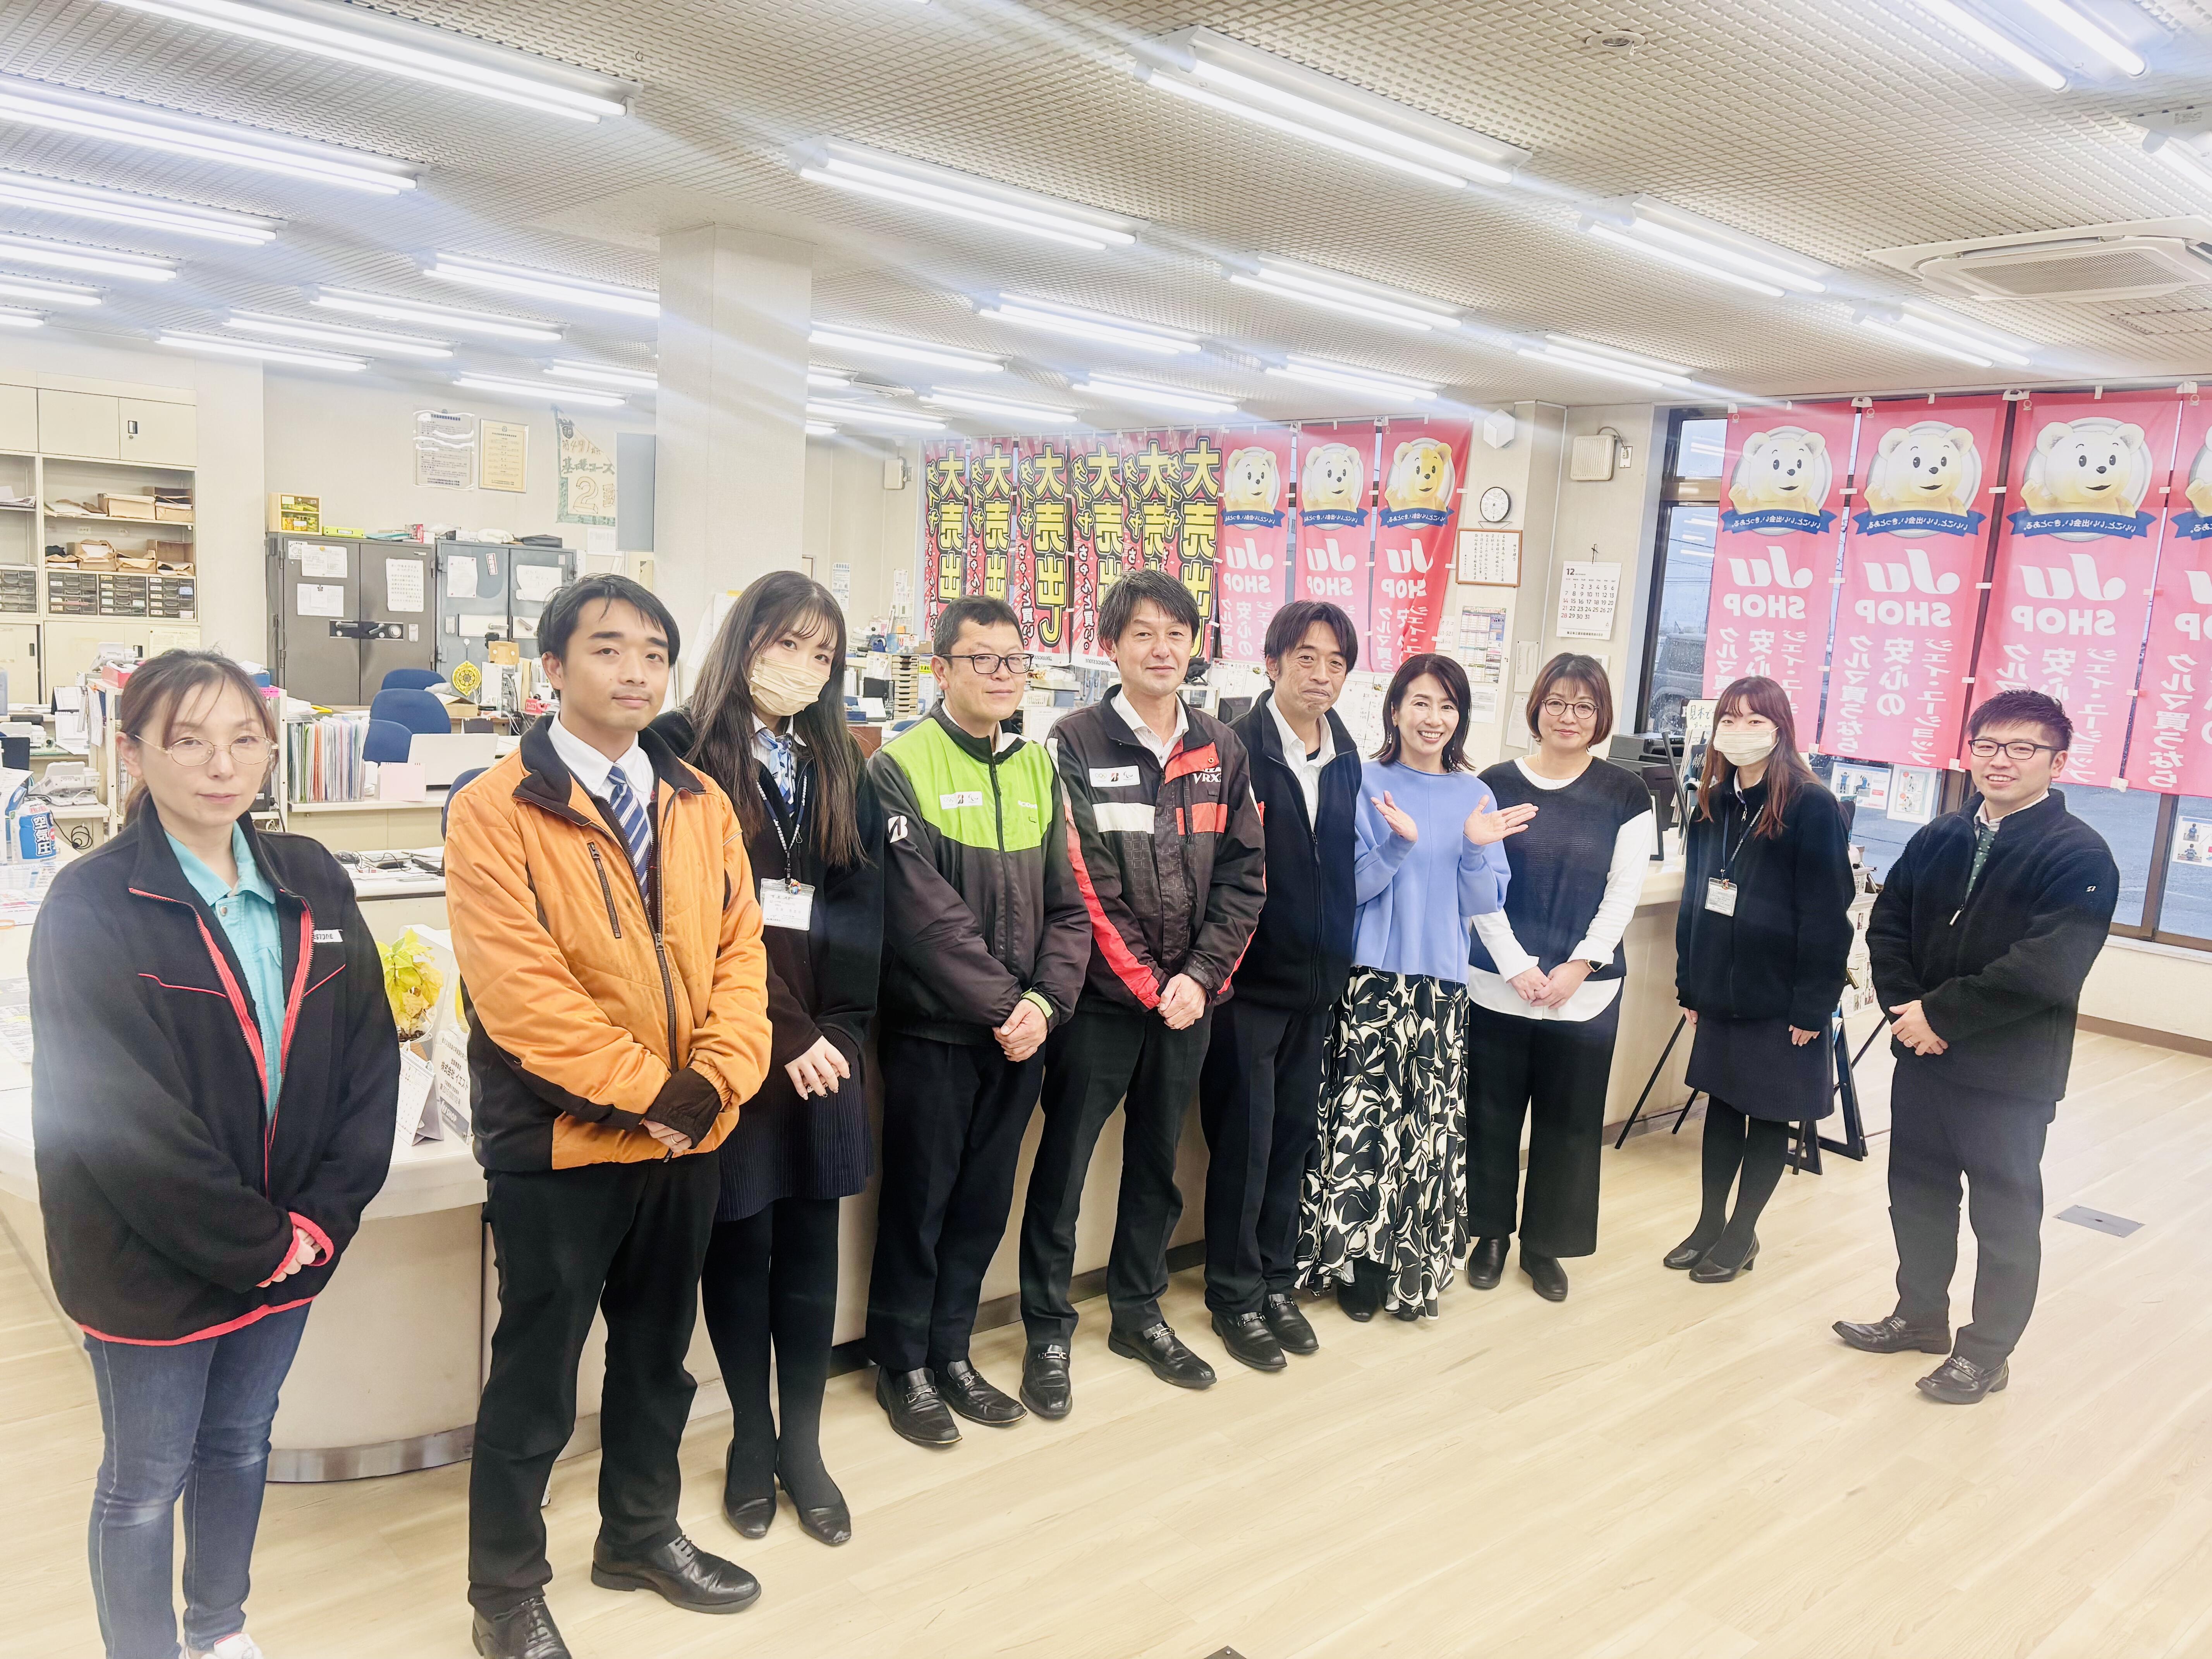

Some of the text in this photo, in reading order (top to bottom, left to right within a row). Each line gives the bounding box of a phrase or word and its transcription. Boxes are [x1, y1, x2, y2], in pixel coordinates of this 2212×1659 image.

[561, 456, 615, 475] 基礎コース
[1192, 773, 1221, 784] VRX
[33, 815, 52, 856] 空気圧
